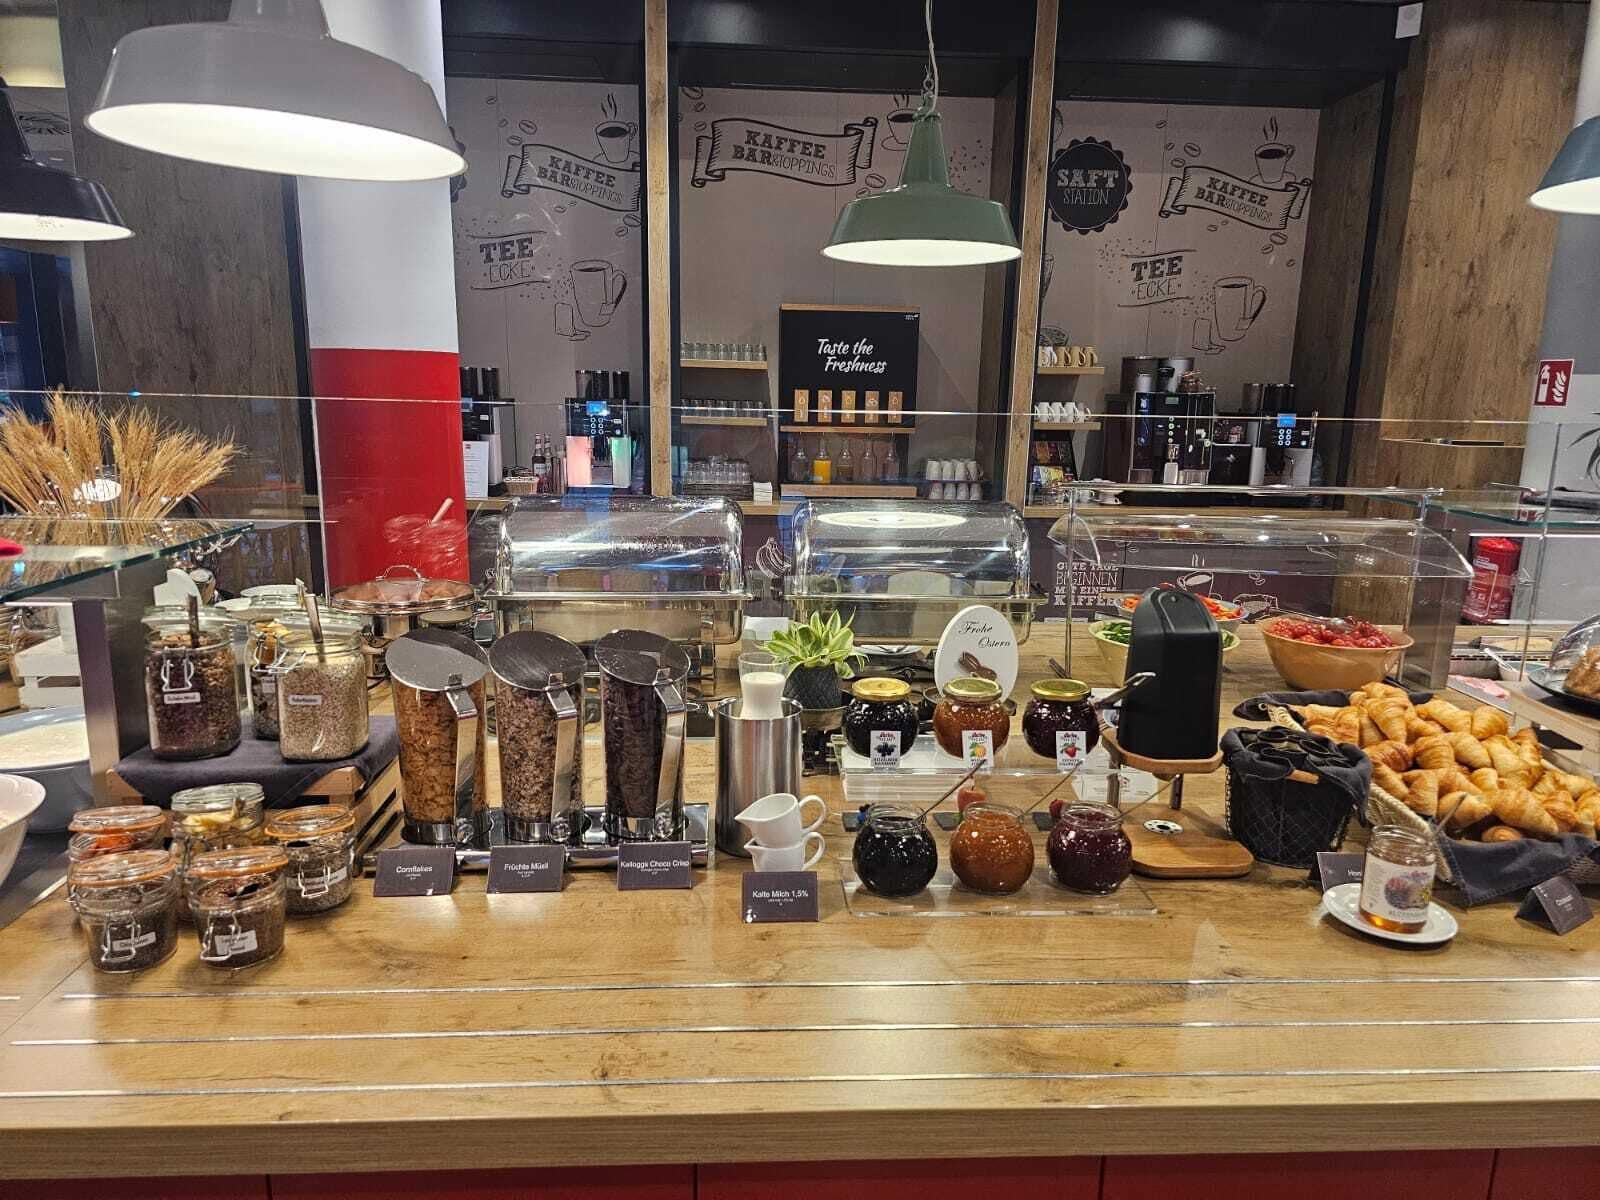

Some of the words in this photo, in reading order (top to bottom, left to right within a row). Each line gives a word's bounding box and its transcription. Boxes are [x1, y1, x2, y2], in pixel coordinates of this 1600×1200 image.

[745, 129, 826, 159] KAFFEE
[548, 155, 616, 188] KAFFEE
[1056, 168, 1120, 189] SAFT
[1063, 187, 1110, 205] STATION
[1206, 176, 1269, 207] KAFFEE
[479, 237, 534, 264] TEE
[1130, 256, 1183, 283] TEE
[1135, 278, 1178, 300] ECKE
[817, 338, 849, 355] Taste
[852, 338, 874, 355] the
[824, 355, 887, 374] Freshness
[1054, 586, 1076, 594] MT
[395, 865, 433, 873] Cornflakes
